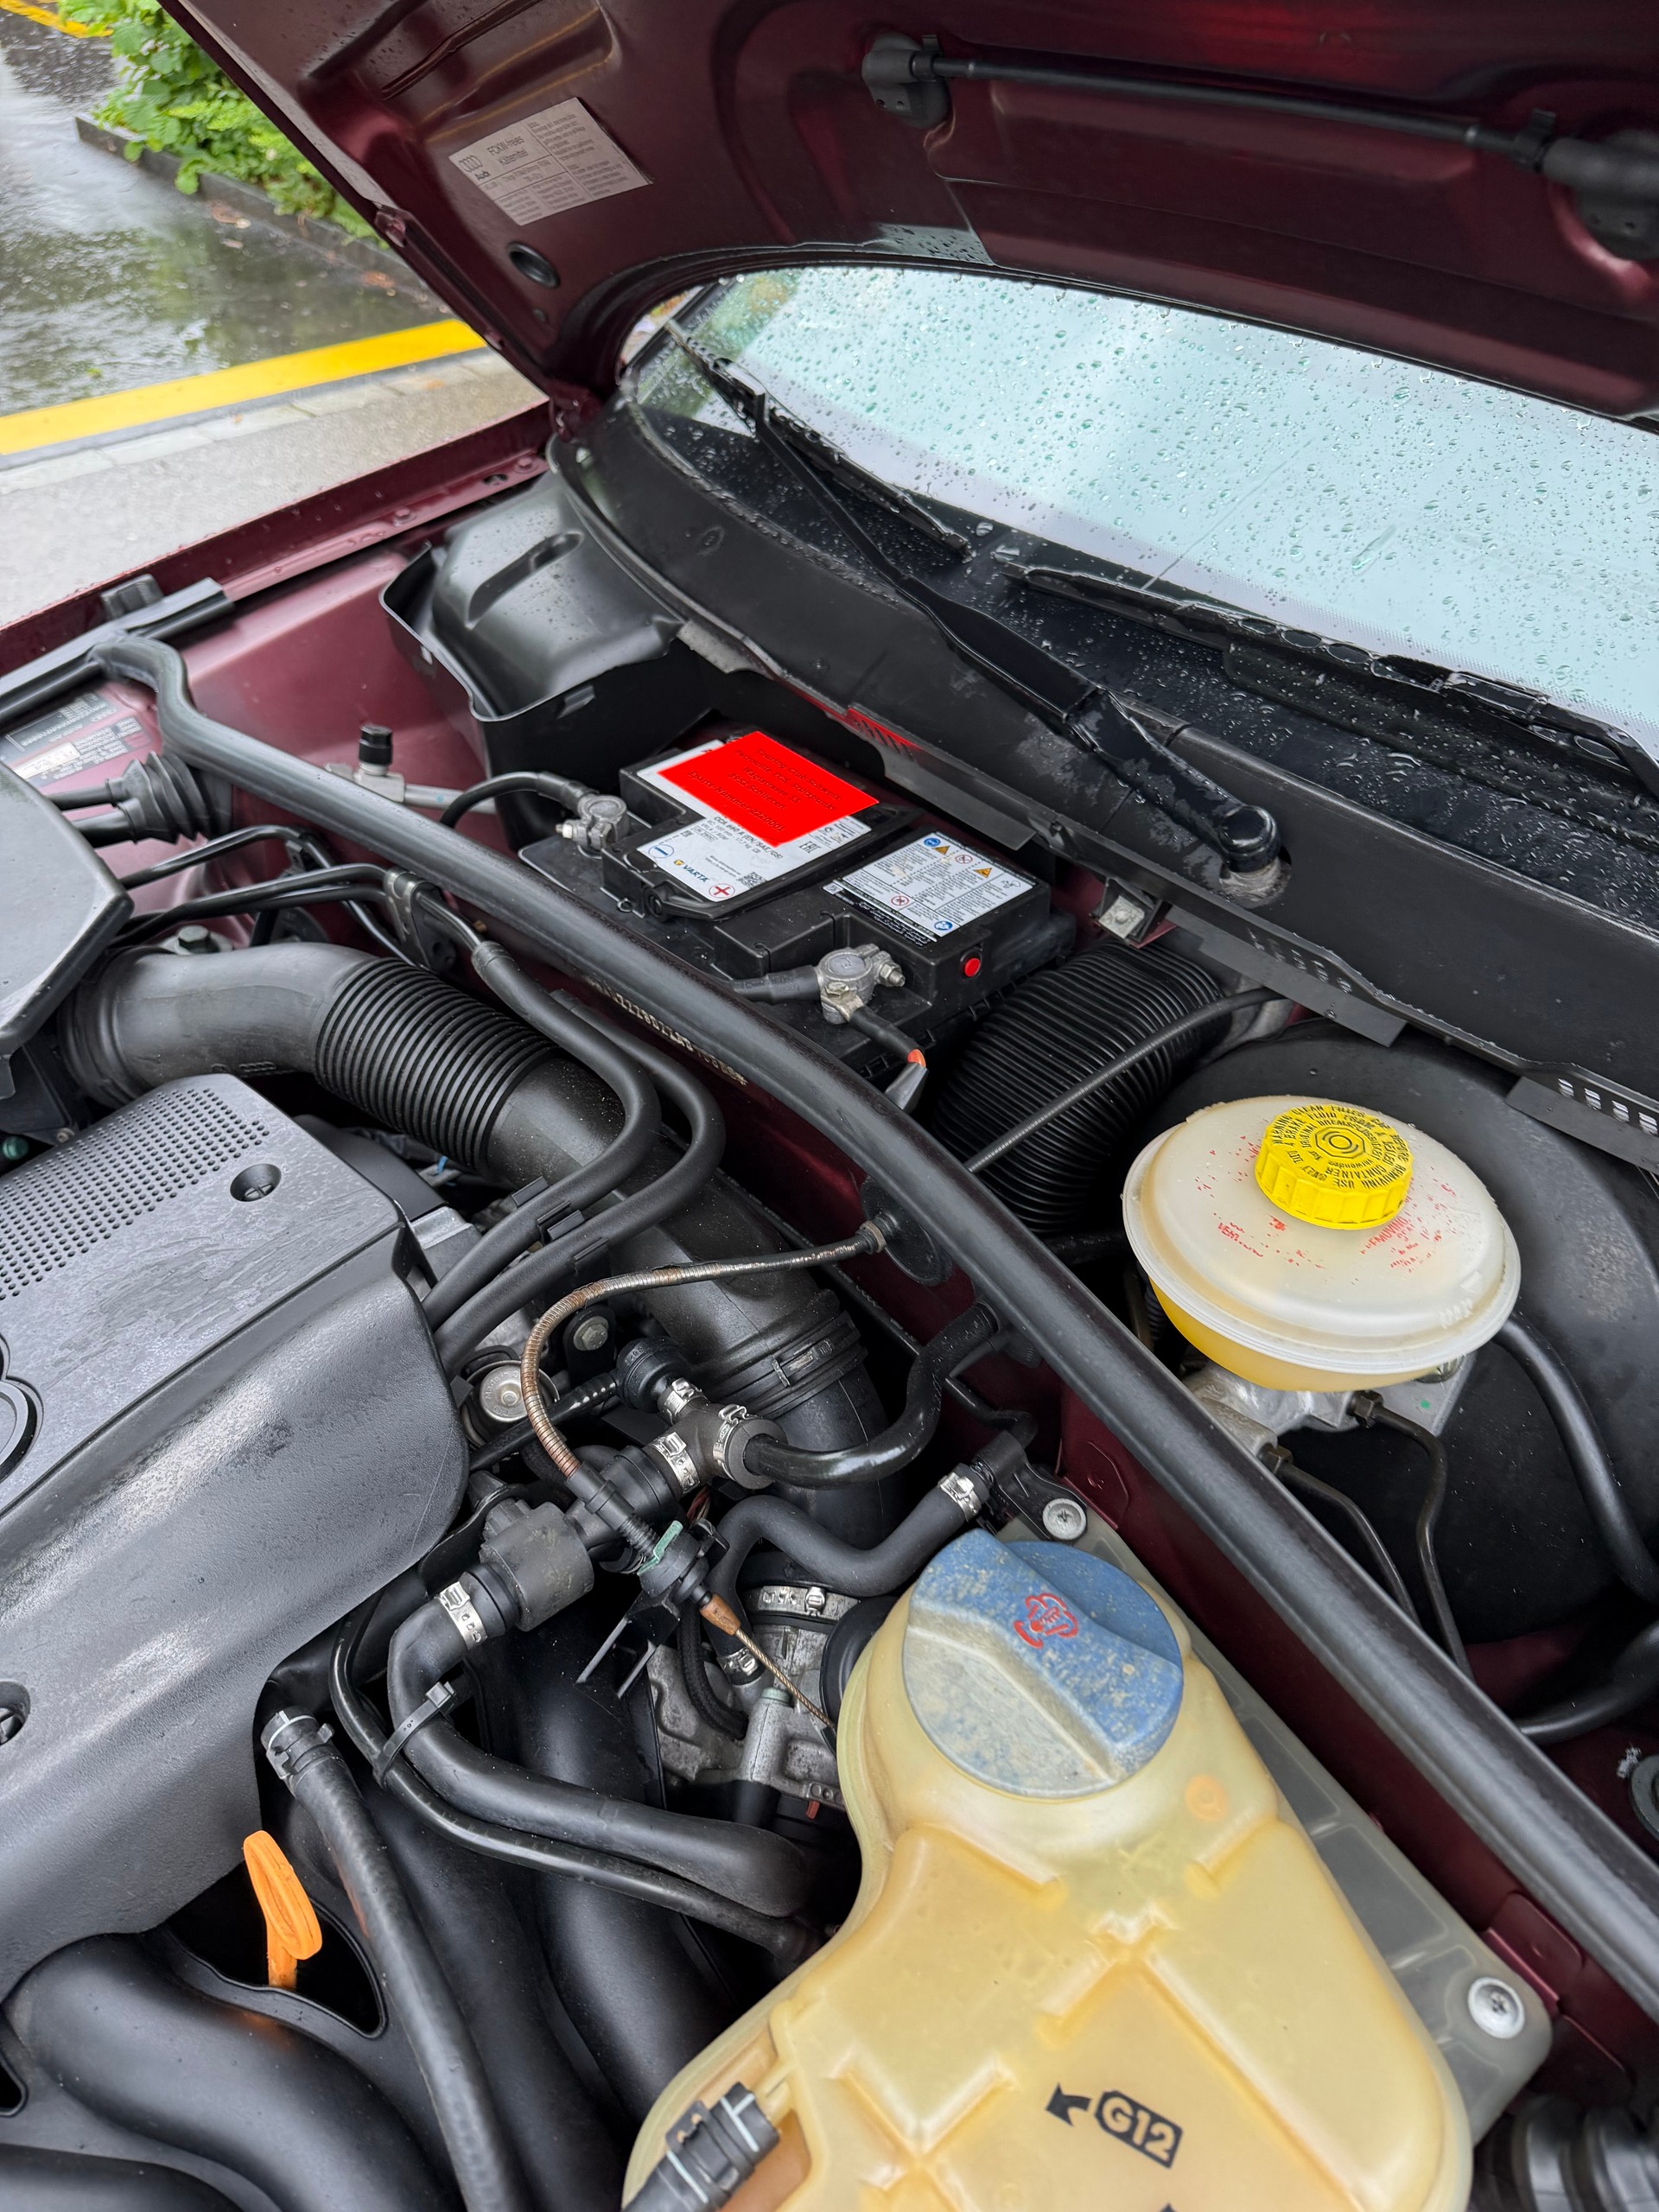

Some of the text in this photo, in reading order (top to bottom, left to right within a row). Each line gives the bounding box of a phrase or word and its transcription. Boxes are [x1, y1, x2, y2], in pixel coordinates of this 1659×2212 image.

[728, 772, 788, 810] 8952 Schlieren
[757, 748, 842, 800] Touring Club Schweiz
[683, 865, 709, 882] VARTA
[1332, 1178, 1356, 1190] USE
[1102, 2096, 1175, 2162] G12
